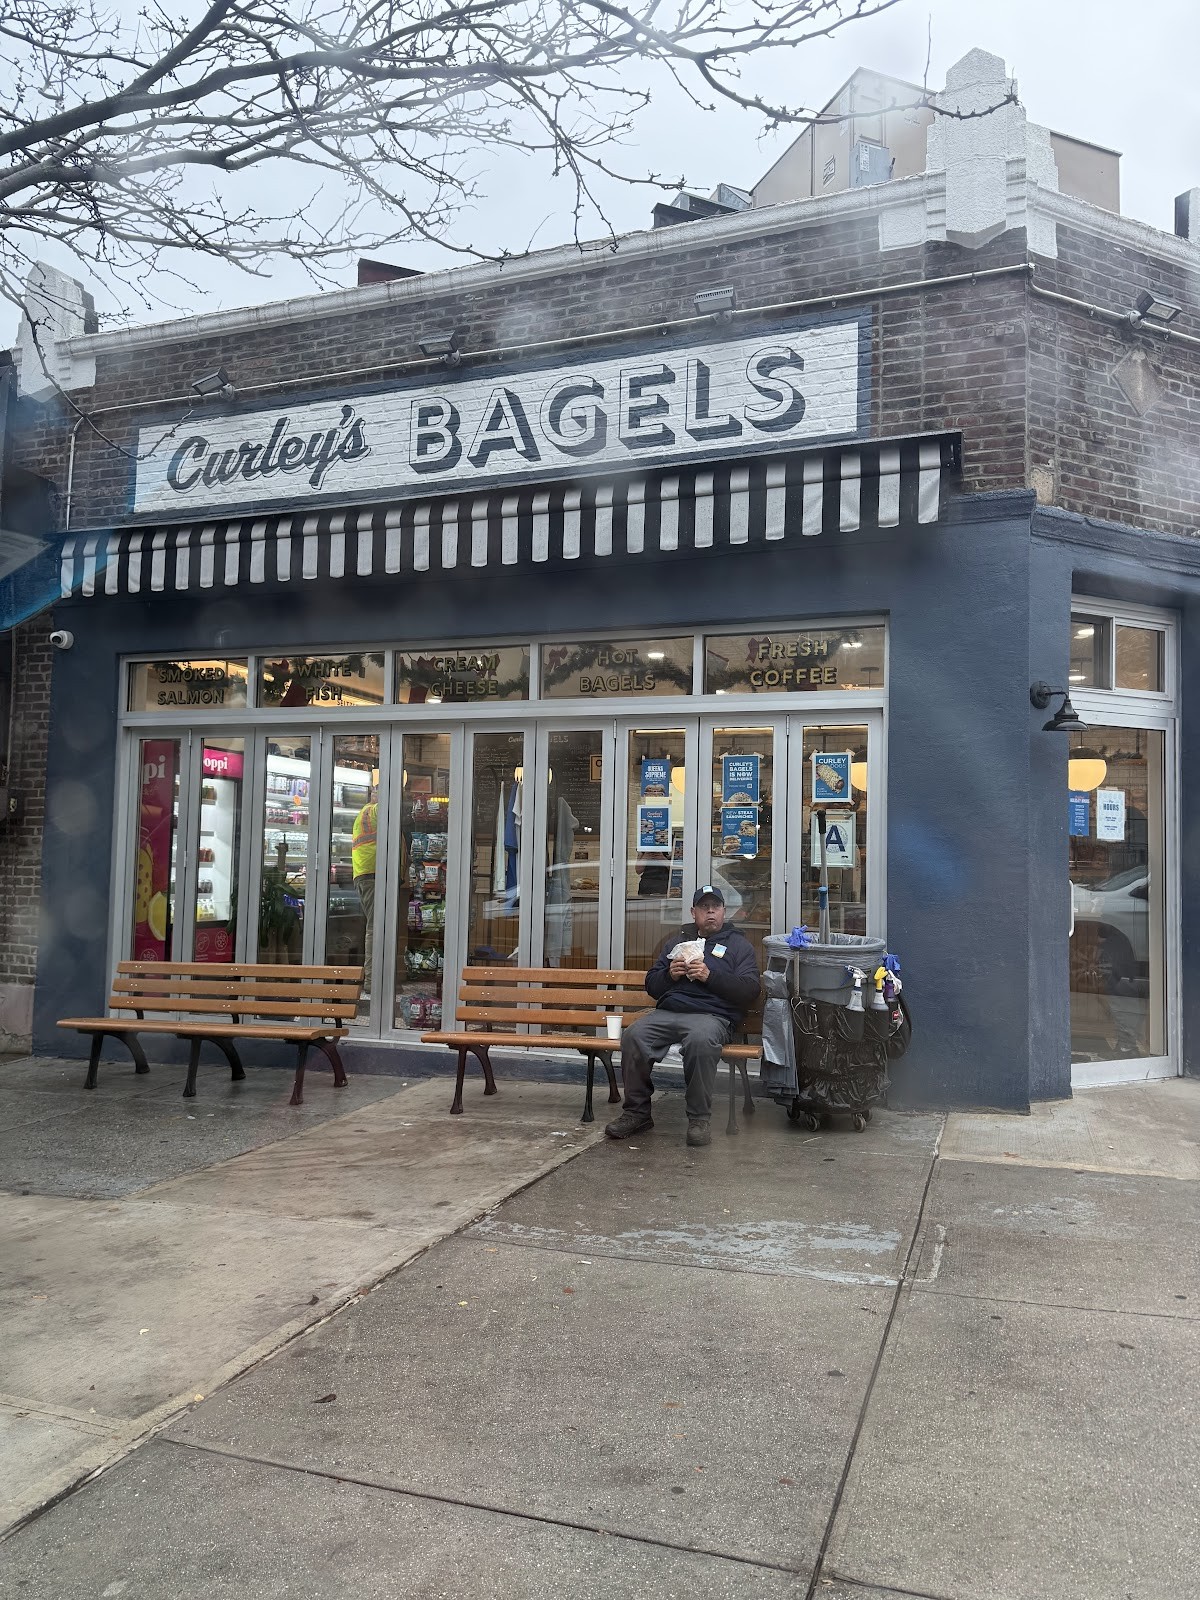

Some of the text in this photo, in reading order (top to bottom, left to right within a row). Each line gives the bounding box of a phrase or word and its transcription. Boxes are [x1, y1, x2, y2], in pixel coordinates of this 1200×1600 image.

[167, 345, 806, 494] Curley's BAGELS
[597, 648, 639, 666] HOT
[758, 640, 829, 659] FRESH
[297, 661, 351, 678] WHITE
[432, 655, 498, 672] CREAM
[159, 666, 226, 683] SMOKED
[579, 674, 656, 692] BAGELS
[750, 667, 837, 686] COFFEE
[157, 688, 225, 705] SALMON
[304, 686, 343, 701] FISH
[431, 680, 499, 696] CHEESE
[203, 757, 228, 772] oppi
[1103, 803, 1120, 811] HOURS
[825, 824, 846, 852] A
